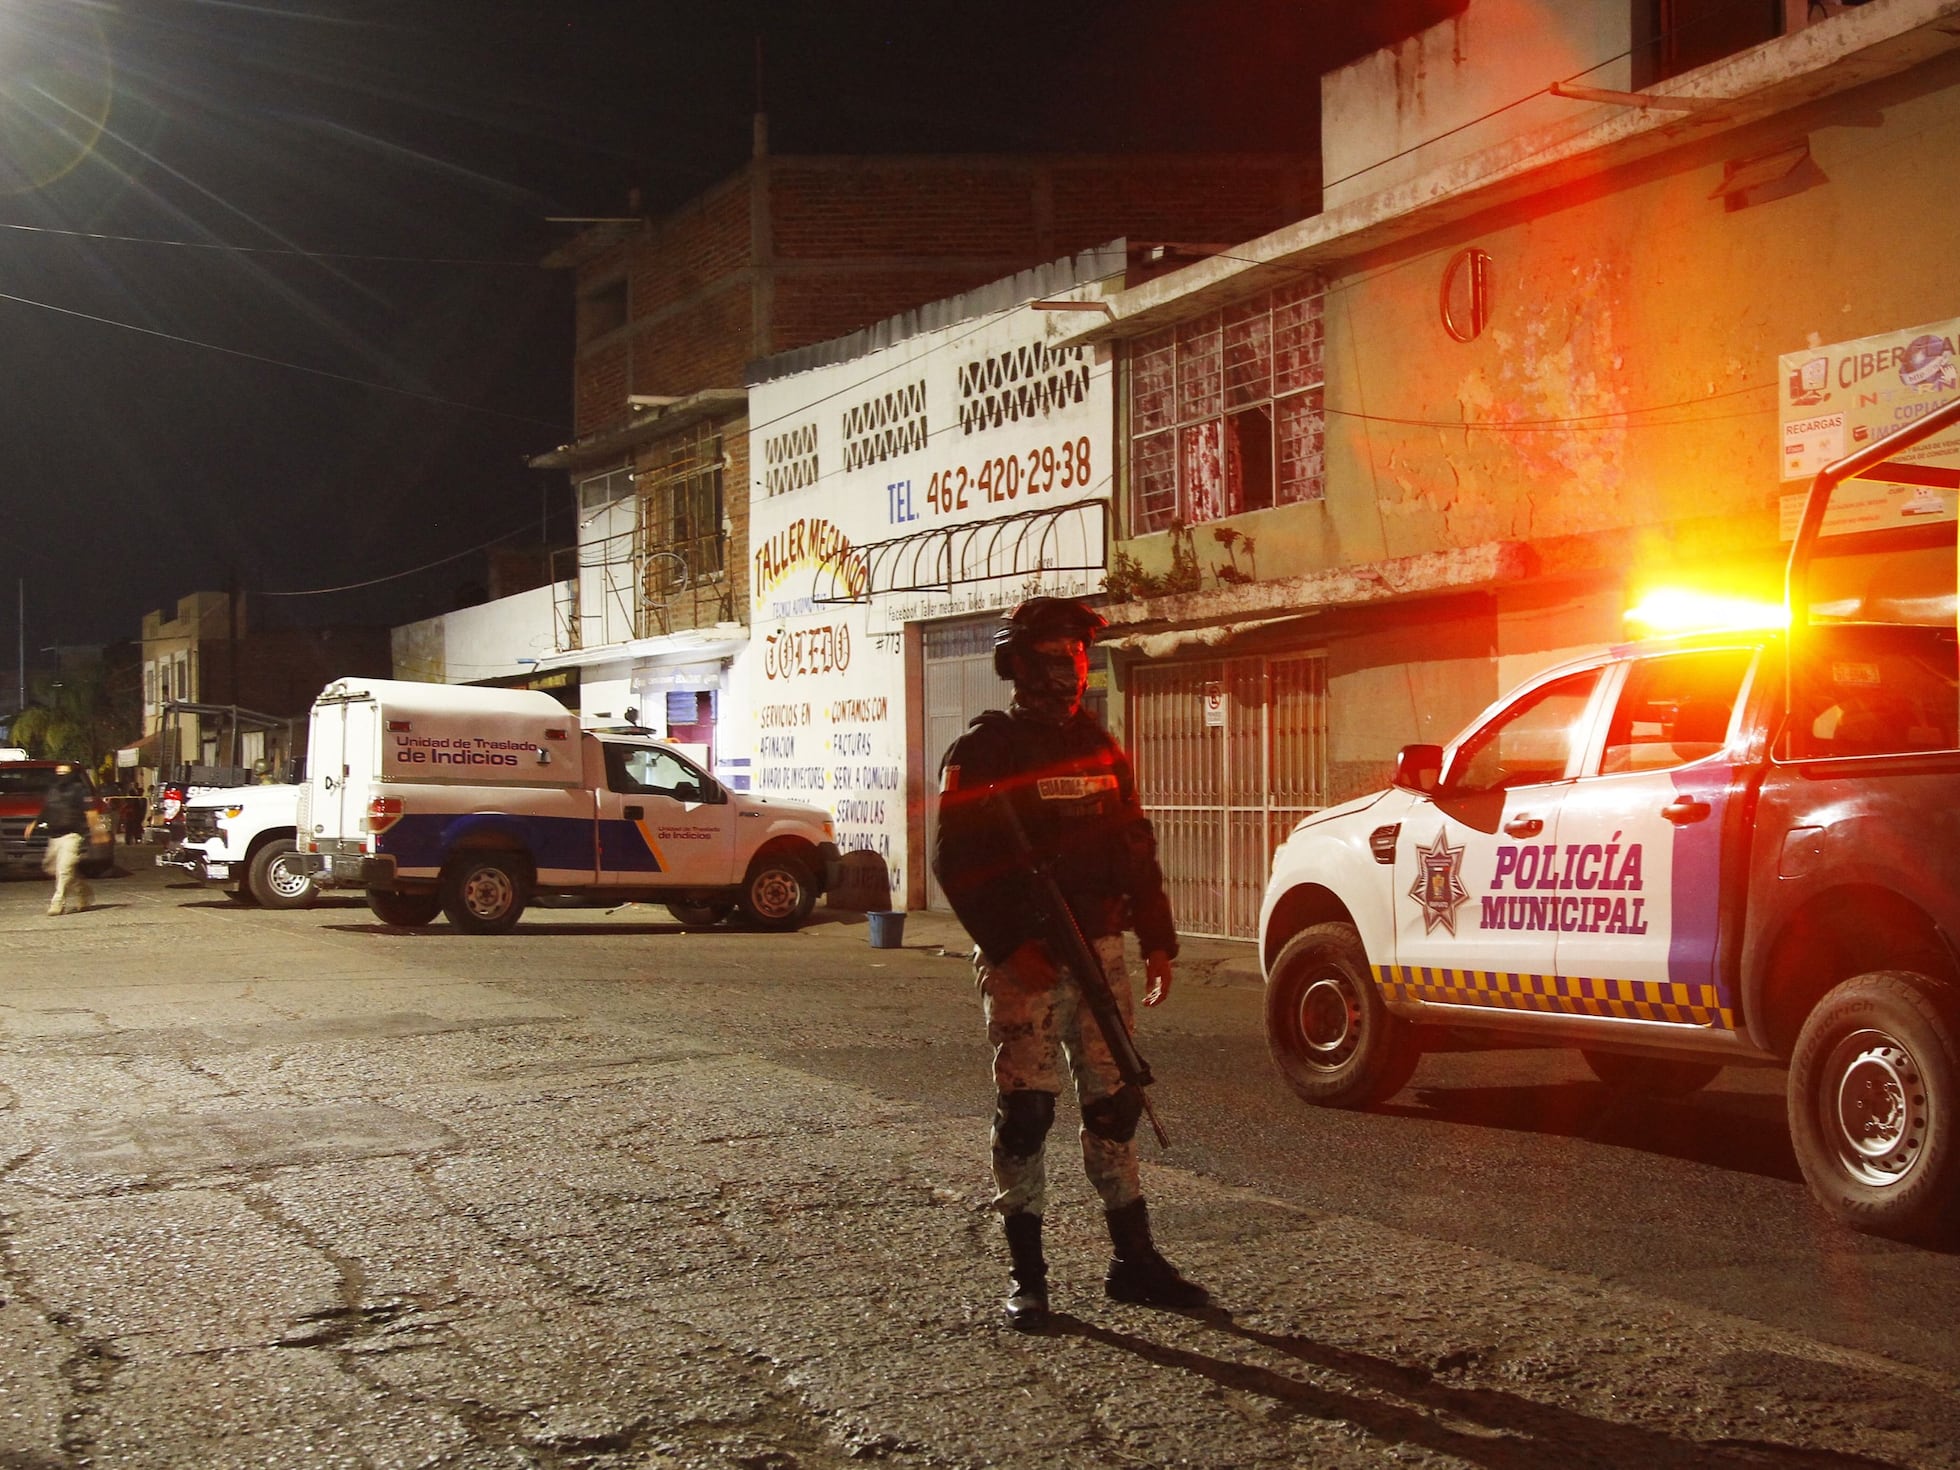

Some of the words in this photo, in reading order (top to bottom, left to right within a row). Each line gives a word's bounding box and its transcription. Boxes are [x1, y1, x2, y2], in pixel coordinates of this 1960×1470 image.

[1786, 417, 1842, 435] RECARGAS
[887, 480, 919, 524] TEL.
[755, 518, 805, 598] TALLER
[765, 622, 850, 680] TOLEDO
[761, 704, 798, 729] SERVICIOS
[801, 702, 811, 727] EN
[832, 698, 870, 724] CONTAMOS
[871, 696, 887, 722] CON
[396, 736, 450, 748] Unidad
[452, 738, 471, 749] de
[473, 738, 538, 751] Traslado
[397, 748, 426, 763] de
[431, 748, 518, 766] Indicios
[834, 732, 871, 757] FACTURAS
[836, 799, 868, 824] SERVICIO
[870, 800, 885, 825] LAS
[673, 832, 711, 840] Indicios
[1490, 830, 1643, 891] POLICÍA
[1480, 896, 1648, 935] MUNICIPAL
